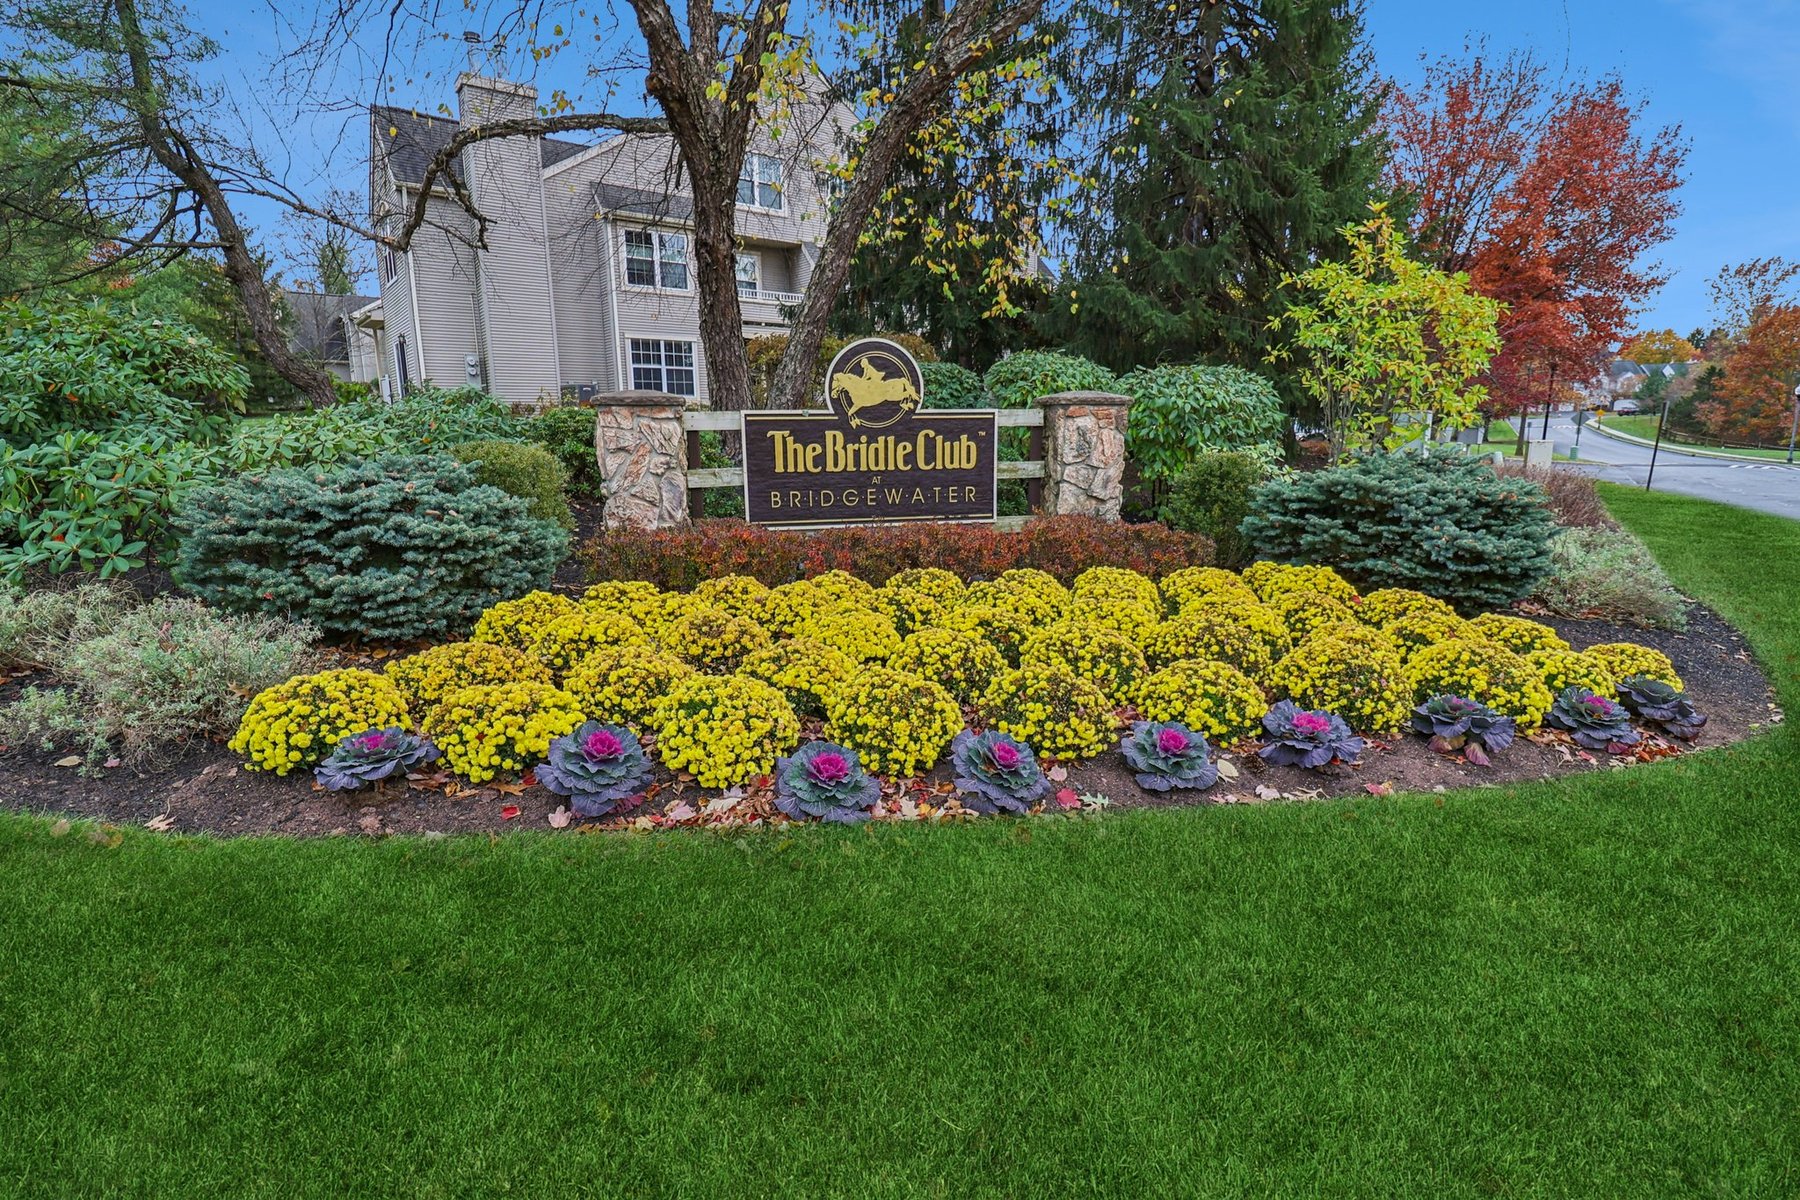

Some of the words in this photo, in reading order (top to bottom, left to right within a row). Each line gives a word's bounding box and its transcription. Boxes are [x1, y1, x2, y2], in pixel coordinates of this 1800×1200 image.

[766, 430, 823, 473] The
[824, 430, 913, 473] Bridle
[916, 429, 977, 471] Club
[871, 476, 882, 485] AT
